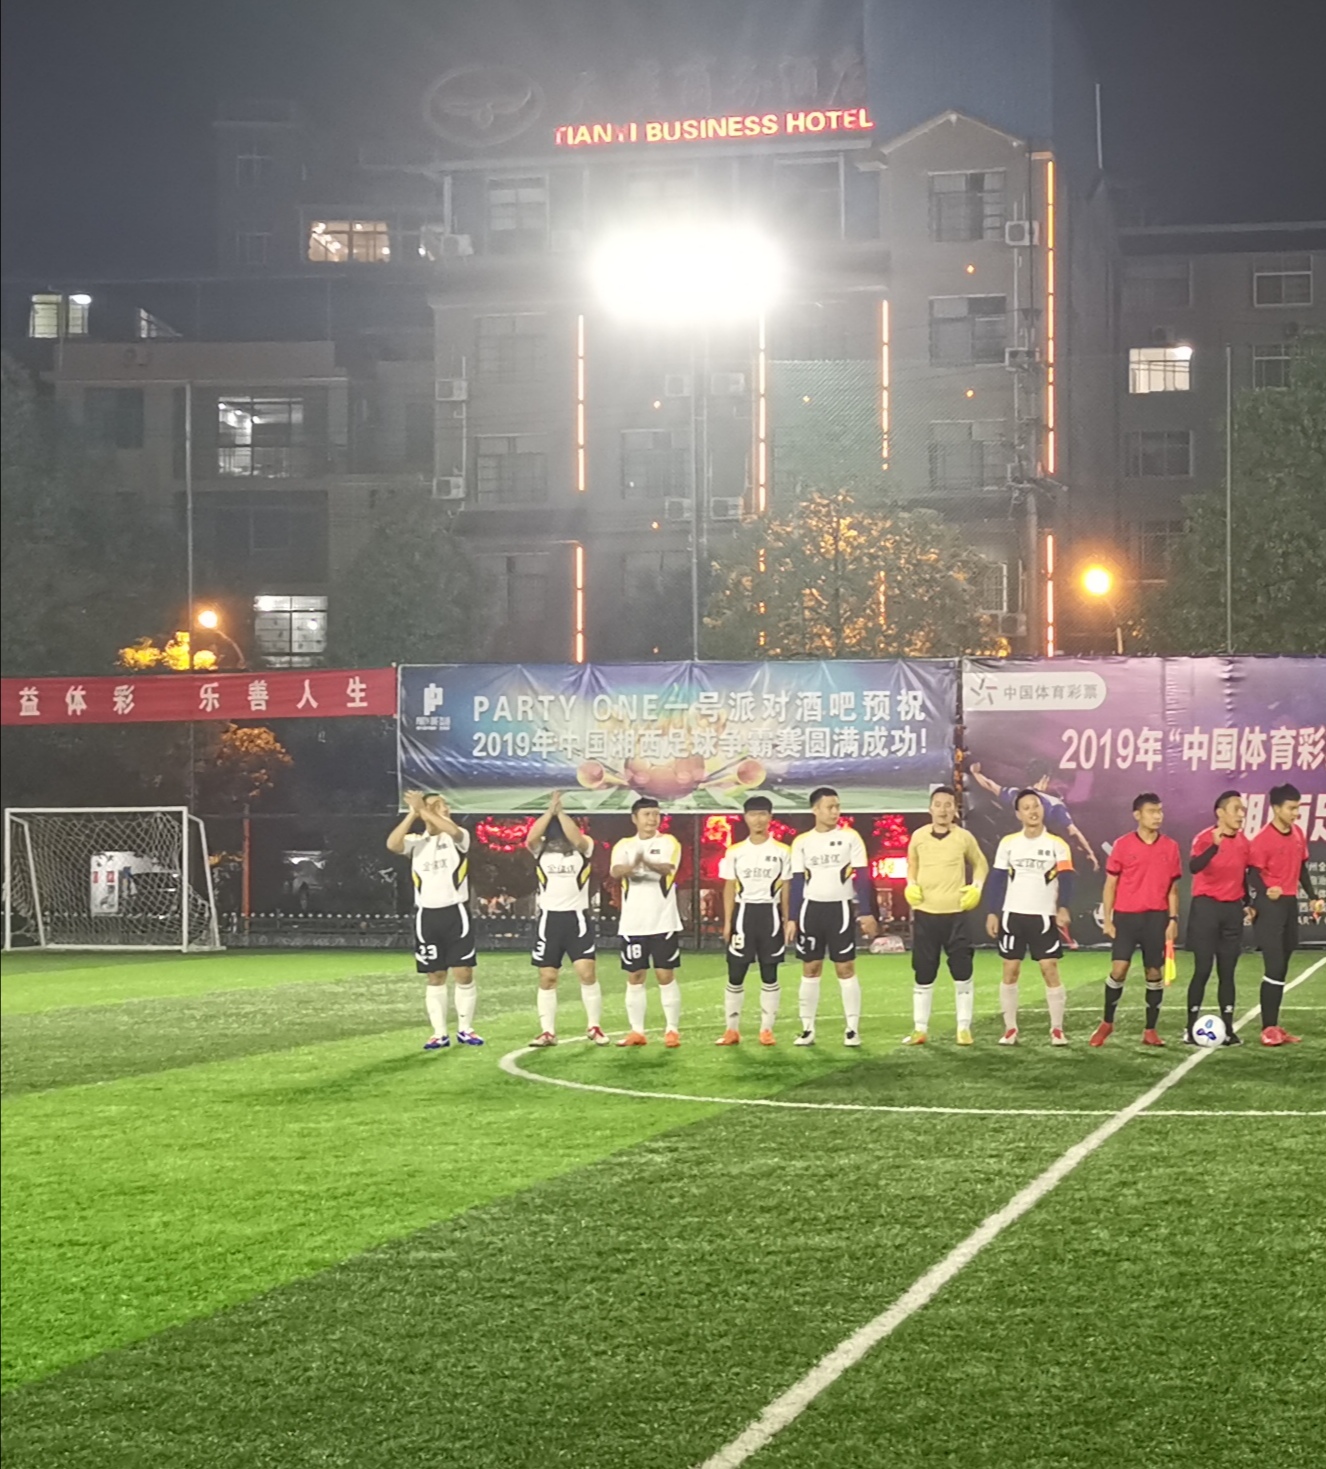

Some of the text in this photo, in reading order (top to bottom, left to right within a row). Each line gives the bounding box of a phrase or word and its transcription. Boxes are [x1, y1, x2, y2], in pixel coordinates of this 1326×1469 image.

[645, 113, 778, 142] BUSINESS
[786, 107, 874, 134] HOTEL
[198, 676, 369, 712] 乐善人生
[1003, 684, 1098, 701] 中国体育彩票
[473, 695, 577, 722] PARTY
[626, 943, 642, 960] 18
